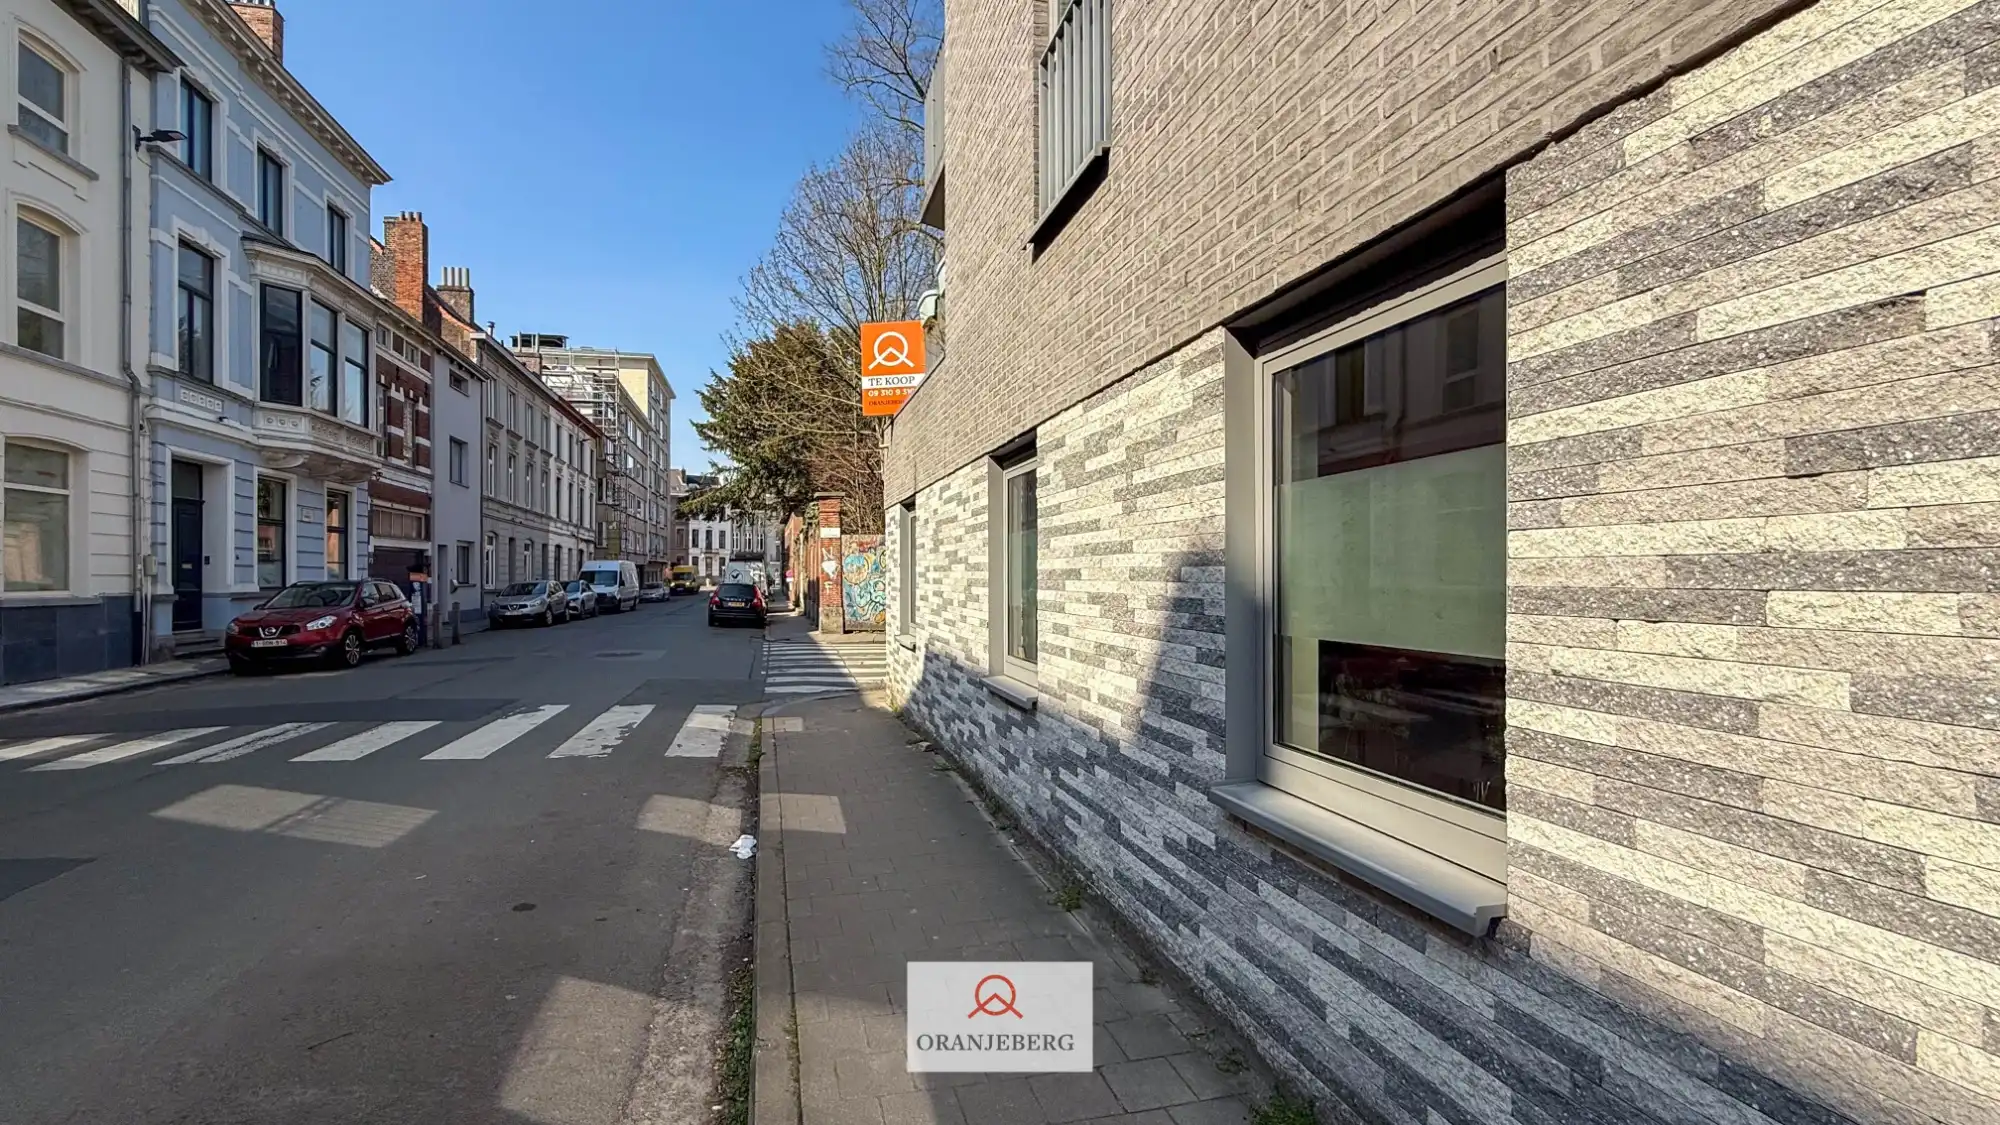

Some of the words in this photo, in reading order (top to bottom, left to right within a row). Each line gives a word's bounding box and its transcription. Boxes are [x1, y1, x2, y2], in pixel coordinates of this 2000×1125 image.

[868, 377, 882, 386] TE
[885, 376, 915, 385] KOOP
[880, 389, 894, 397] 310
[895, 388, 901, 396] 9
